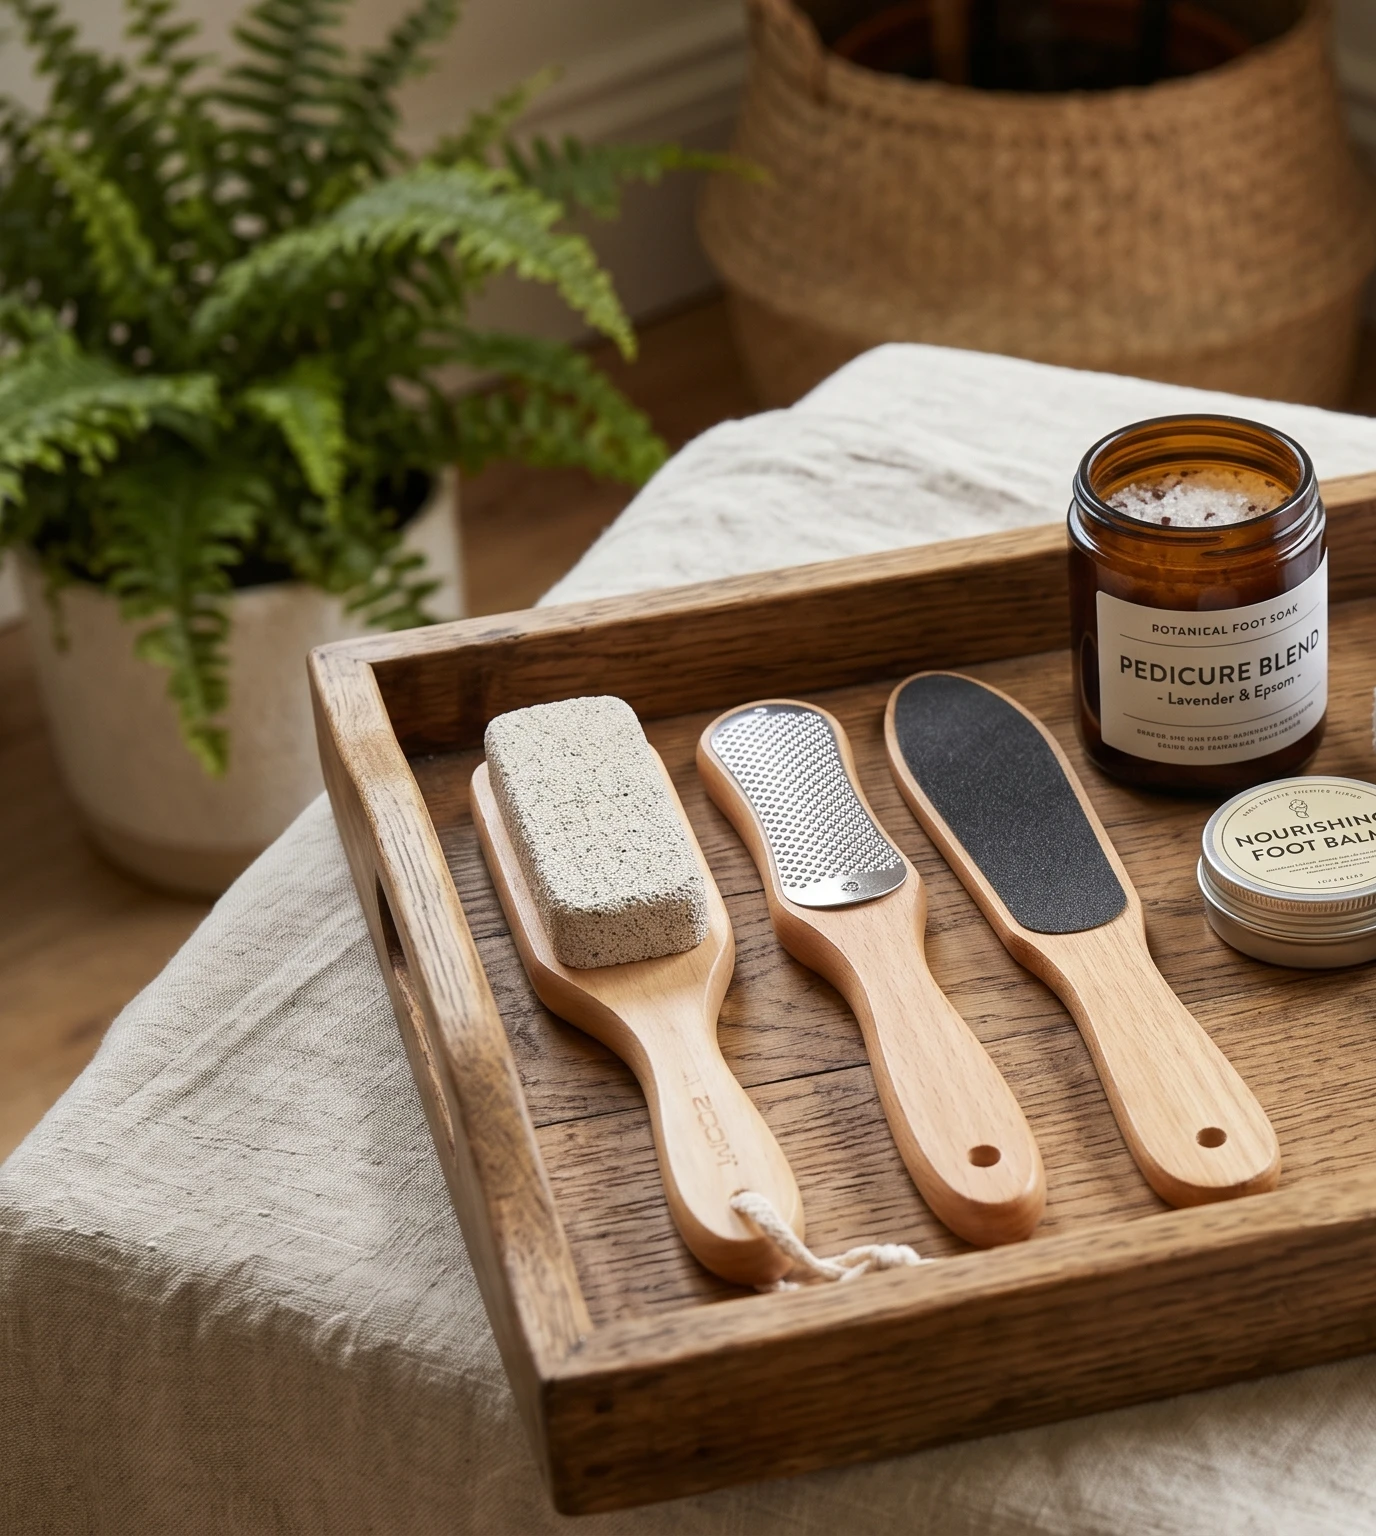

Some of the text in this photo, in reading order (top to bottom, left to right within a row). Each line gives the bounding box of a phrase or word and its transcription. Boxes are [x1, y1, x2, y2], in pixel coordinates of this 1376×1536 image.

[1232, 617, 1266, 633] FOOT
[1270, 603, 1298, 623] SOAK
[1120, 629, 1319, 686] PEDICURE BLEND
[1168, 691, 1235, 706] Lavender
[1239, 688, 1250, 701] &
[1254, 676, 1295, 700] Epsom
[1251, 839, 1317, 862] FOOT
